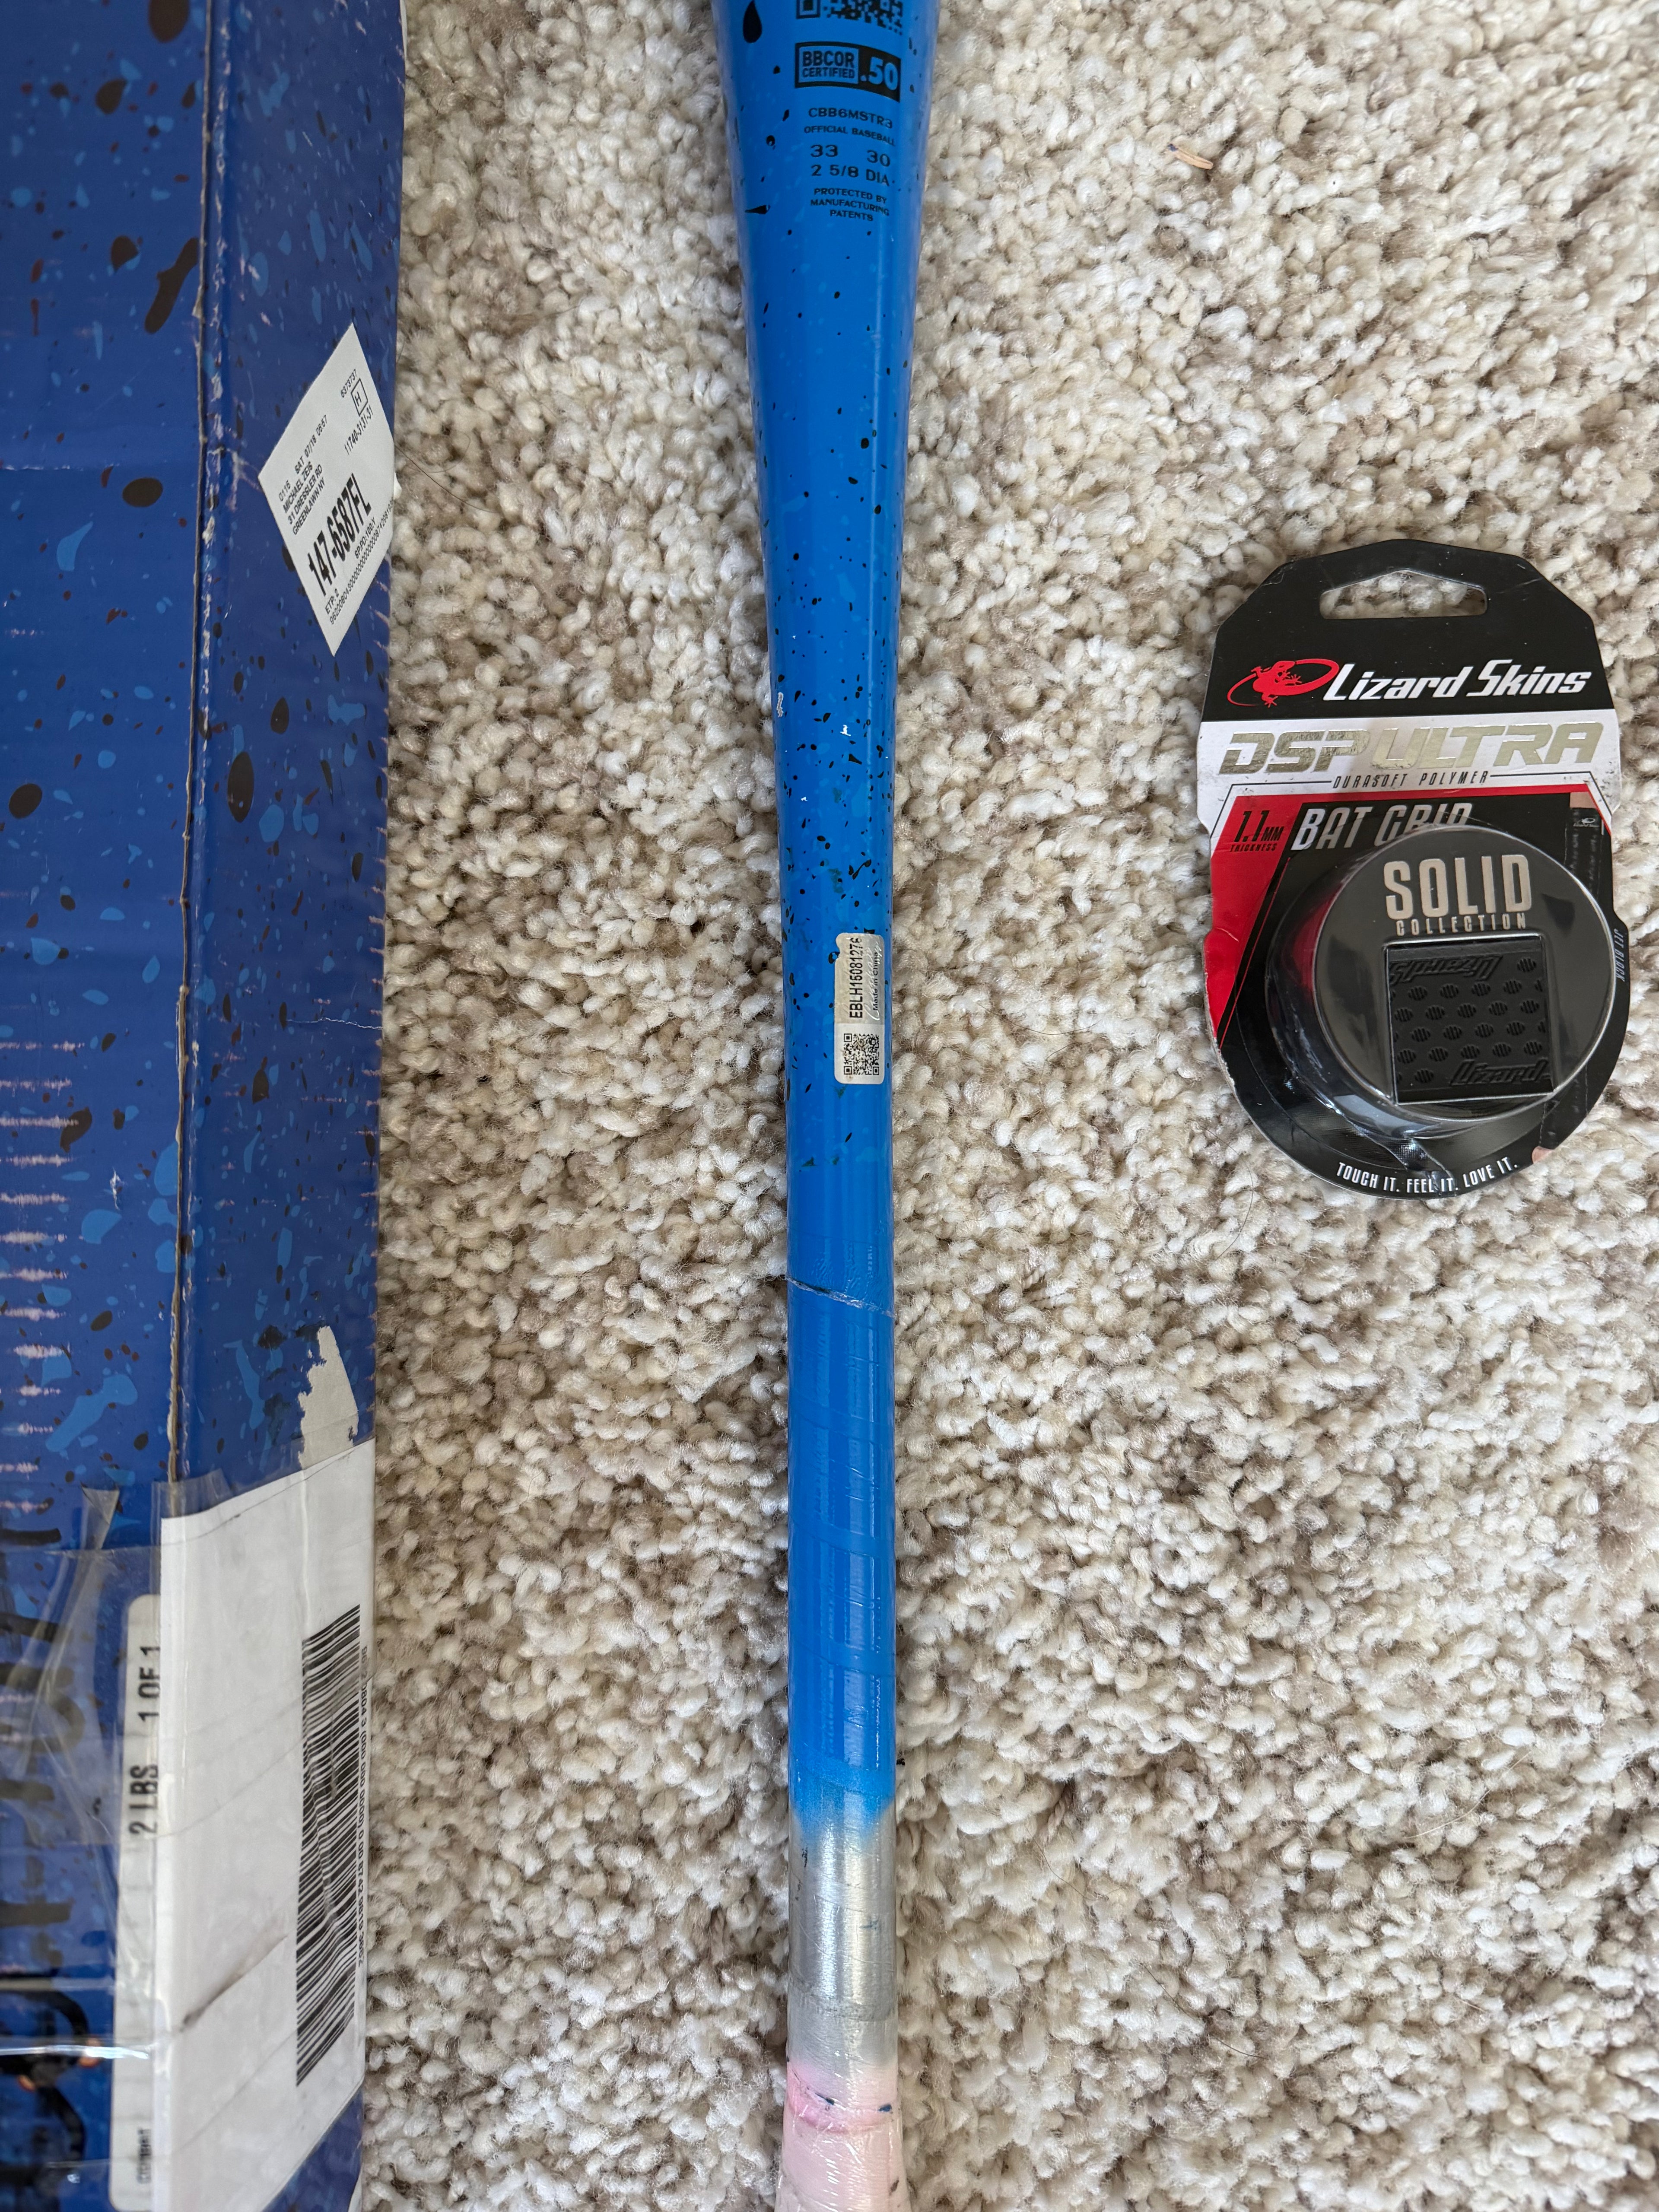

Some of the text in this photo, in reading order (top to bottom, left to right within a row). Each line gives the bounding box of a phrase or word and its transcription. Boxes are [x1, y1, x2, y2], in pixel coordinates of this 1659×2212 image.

[802, 51, 854, 68] BBCOR
[802, 67, 855, 79] CERTIFIED
[860, 57, 898, 90] .50
[808, 108, 893, 129] CBB6MSTR3
[804, 125, 895, 146] OFFICIAL BASEBALL
[810, 144, 891, 167] 33 30
[811, 164, 822, 176] 2
[830, 164, 859, 178] 5/8
[810, 198, 890, 216] MANUFACTURING
[814, 188, 887, 204] PROTECTED BY
[830, 209, 874, 222] PATENTS
[355, 392, 362, 407] H
[295, 456, 304, 474] SAT
[283, 461, 312, 513] MICHAEL ZEIS
[288, 464, 322, 524] 31 DRESSLER RD
[293, 477, 324, 535] GREENLAWN NY
[308, 473, 372, 597] 147-6587FL
[1323, 659, 1592, 701] Lizard Skins
[1219, 721, 1603, 774] DSP ULTRA
[1333, 771, 1488, 788] DURASOFT POLYMER
[1290, 806, 1373, 851] BAT
[1230, 843, 1277, 852] THICKNESS
[1384, 855, 1532, 920] SOLID
[1396, 912, 1526, 936] COLLECTION
[1614, 928, 1625, 982] JET BLACK
[1337, 1156, 1518, 1193] TOUCH IT. FEEL IT. LOVE IT.
[129, 1646, 161, 1834] 2 LBS 1 OF 1
[358, 1829, 364, 1840] 0
[358, 1841, 364, 1859] 00
